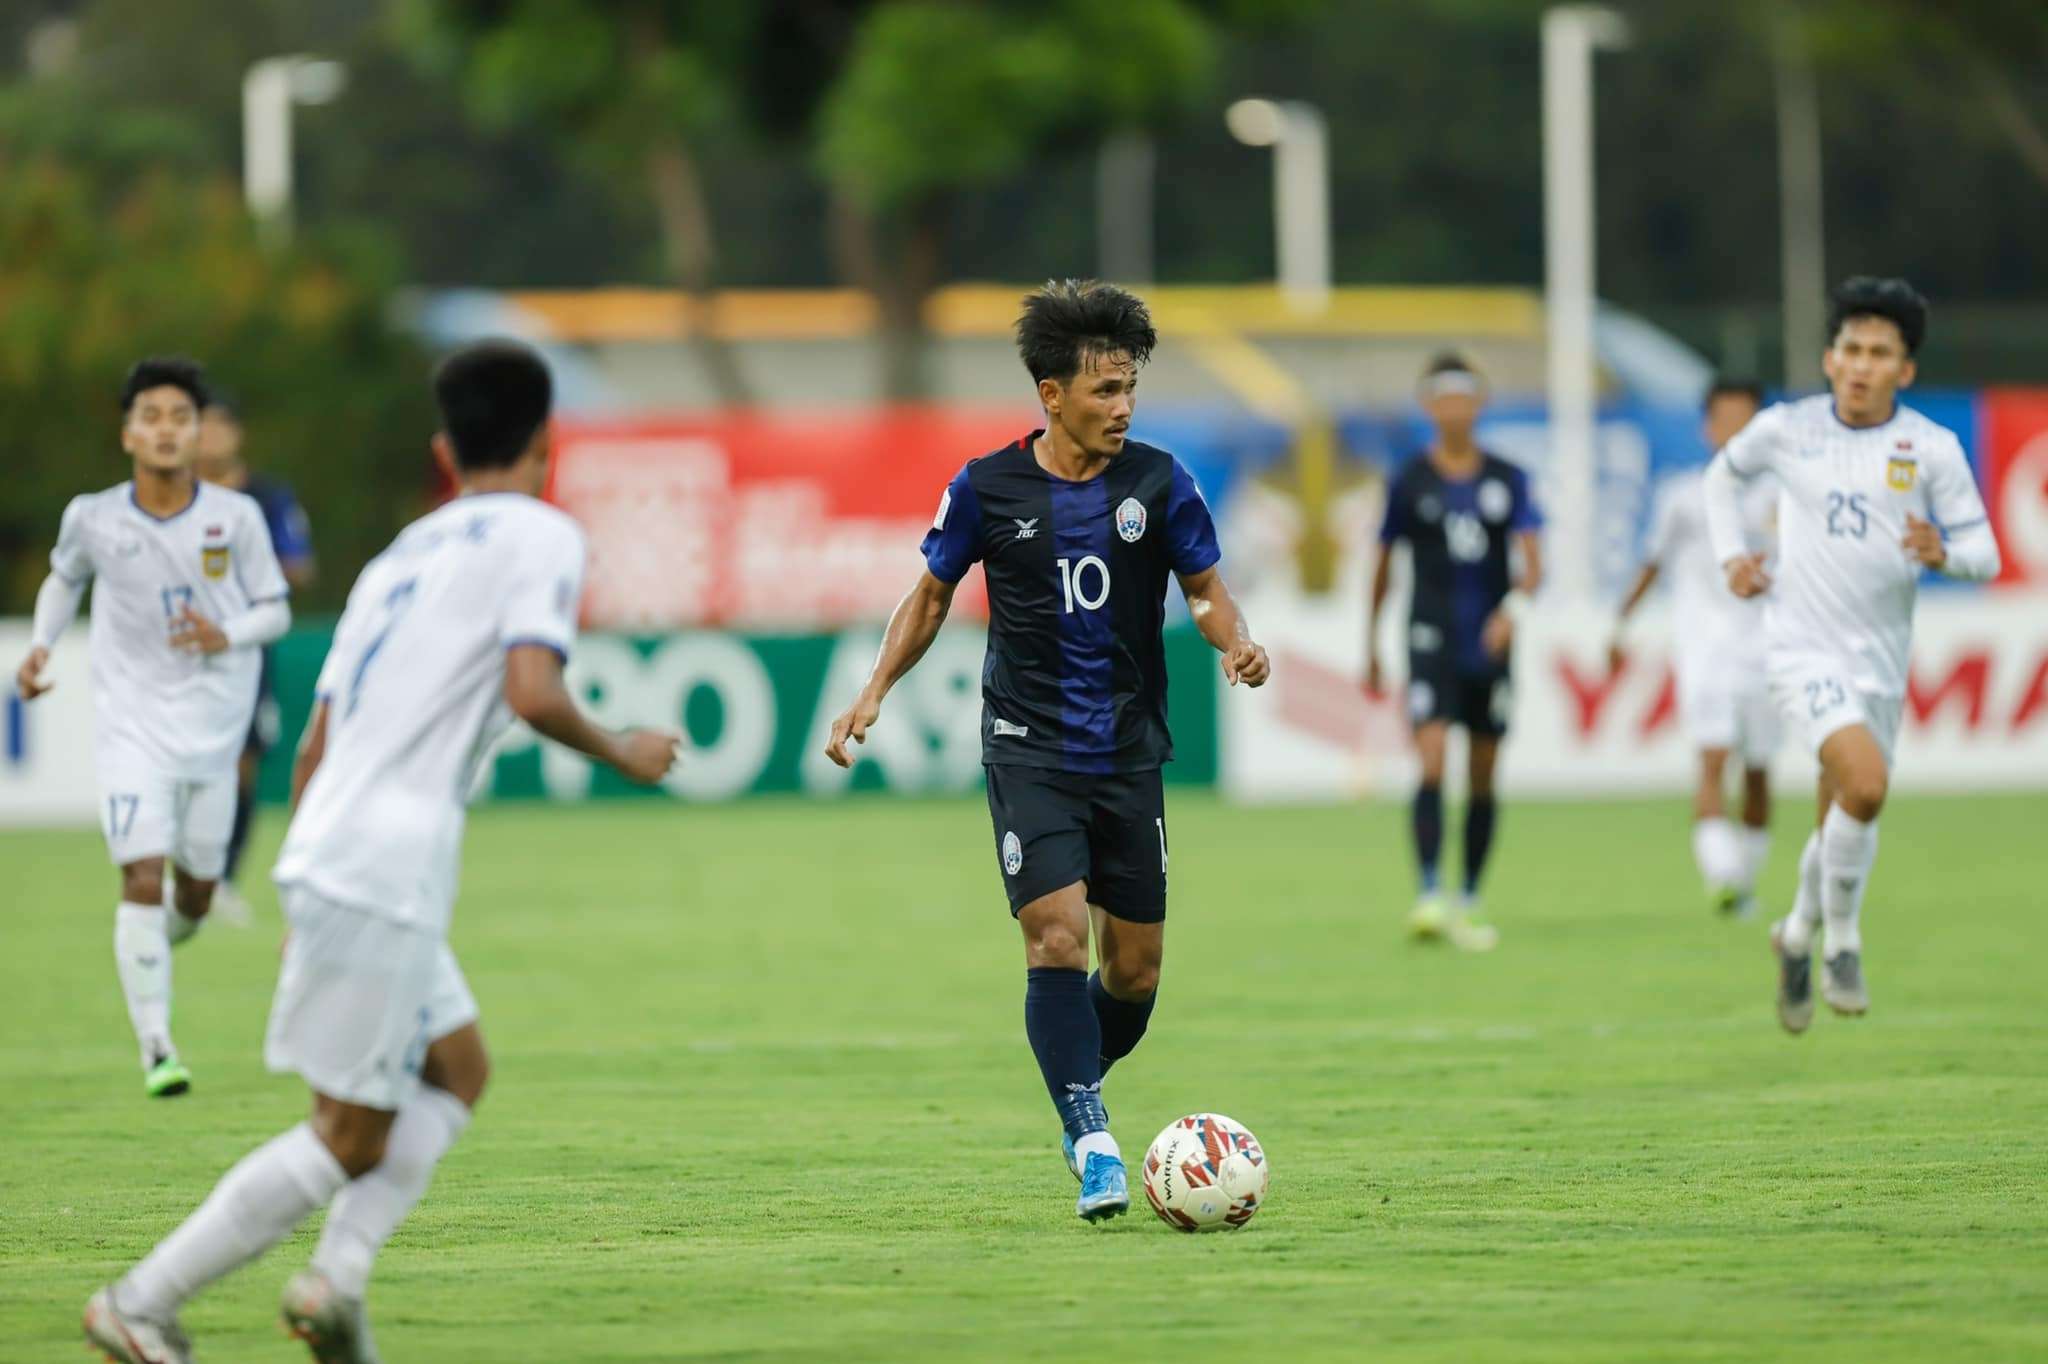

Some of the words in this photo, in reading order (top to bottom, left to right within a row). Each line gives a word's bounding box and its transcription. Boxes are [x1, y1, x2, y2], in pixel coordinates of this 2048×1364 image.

[1826, 489, 1868, 540] 25
[1056, 555, 1111, 614] 10
[108, 792, 140, 838] 17
[1163, 1138, 1180, 1201] WARRIX
